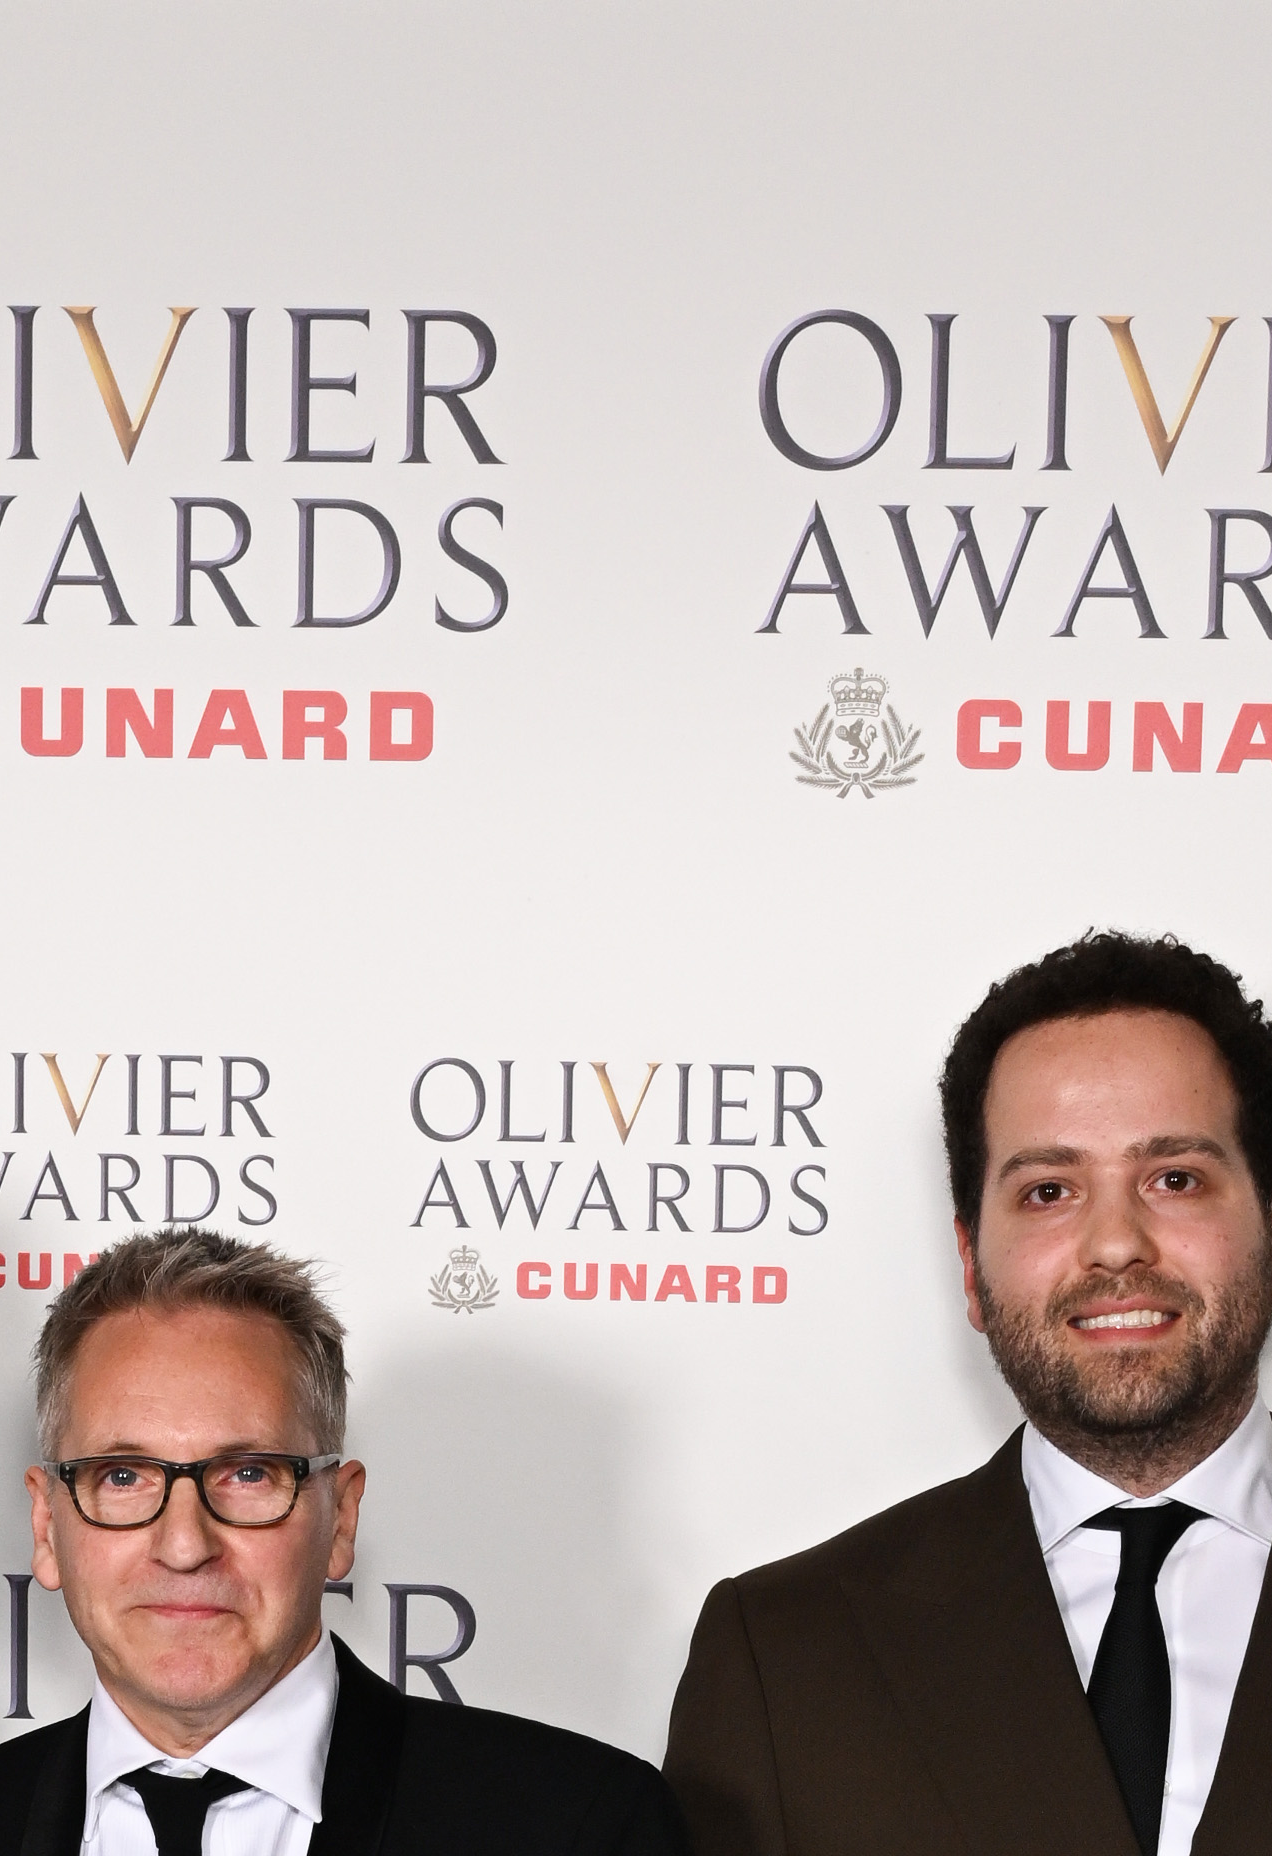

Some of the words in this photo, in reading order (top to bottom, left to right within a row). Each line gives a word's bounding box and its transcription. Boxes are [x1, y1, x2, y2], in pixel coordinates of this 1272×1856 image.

[409, 1057, 828, 1148] OLIVIER
[409, 1157, 829, 1237] AWARDS
[516, 1261, 788, 1304] CUNARD
